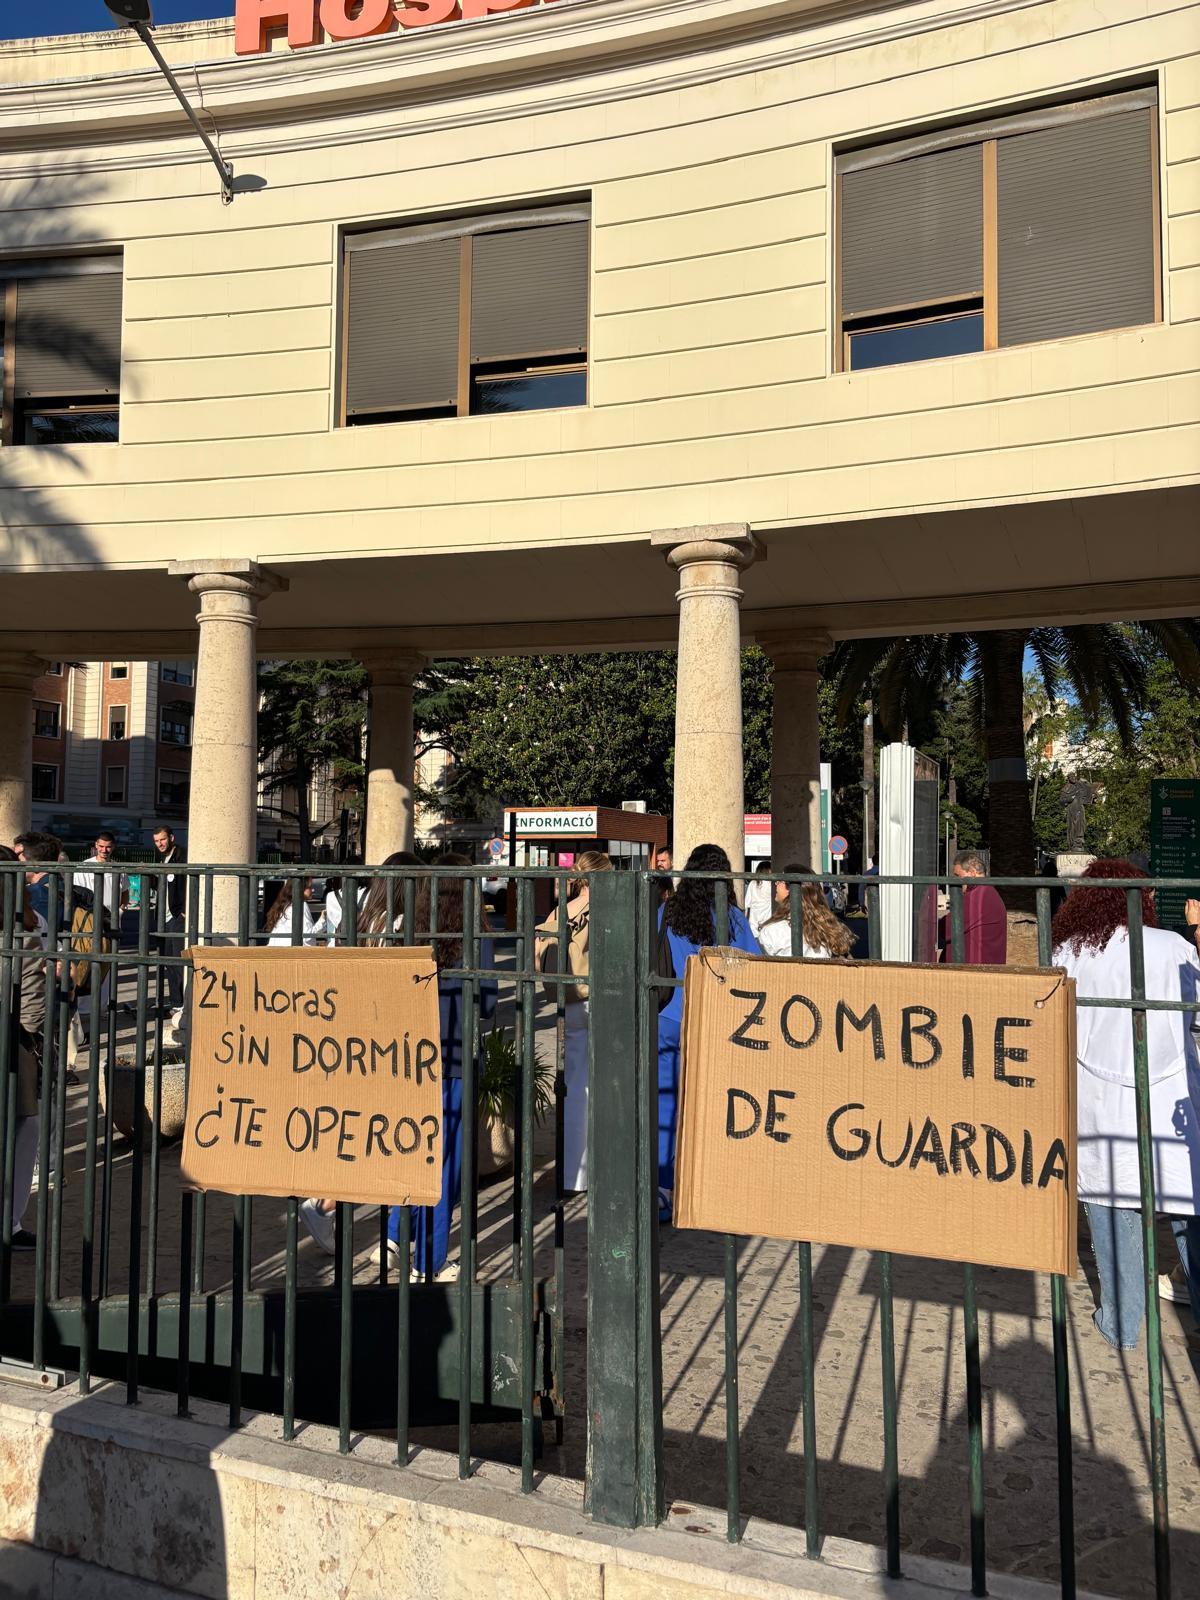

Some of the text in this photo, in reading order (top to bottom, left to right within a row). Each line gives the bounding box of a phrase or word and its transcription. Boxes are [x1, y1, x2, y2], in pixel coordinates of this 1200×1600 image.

[515, 814, 594, 828] INFORMACIÓ
[199, 970, 338, 1021] 24 horas
[729, 988, 1036, 1088] ZOMBIE
[194, 1083, 440, 1163] ¿TE OPERO?
[726, 1088, 1068, 1191] DE GUARDIA
